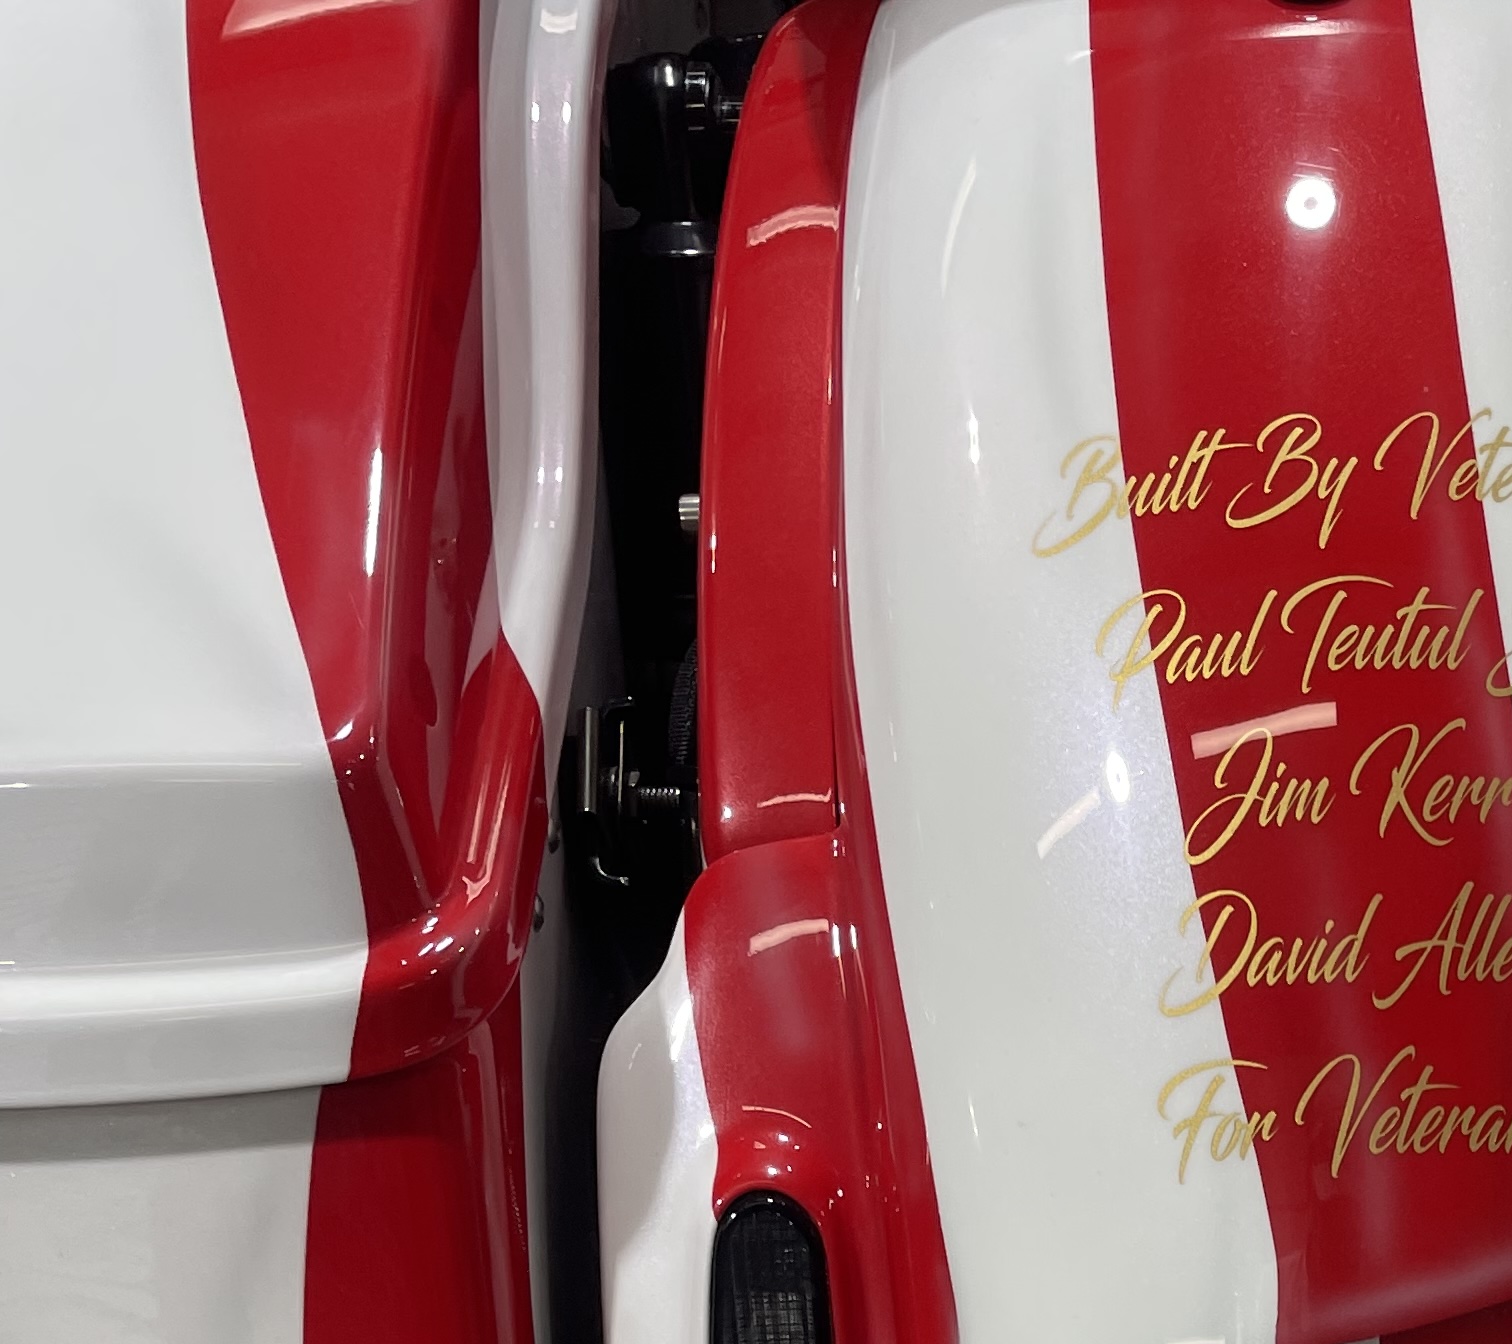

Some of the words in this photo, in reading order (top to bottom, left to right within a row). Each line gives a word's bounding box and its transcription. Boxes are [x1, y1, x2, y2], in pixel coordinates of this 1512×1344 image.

[1032, 428, 1253, 558] Built
[1226, 413, 1359, 548] By
[1096, 589, 1278, 712] Paul
[1280, 575, 1485, 694] Teutul
[1185, 727, 1336, 865] Jim
[1157, 889, 1383, 1017] David
[1157, 1059, 1279, 1185] For
